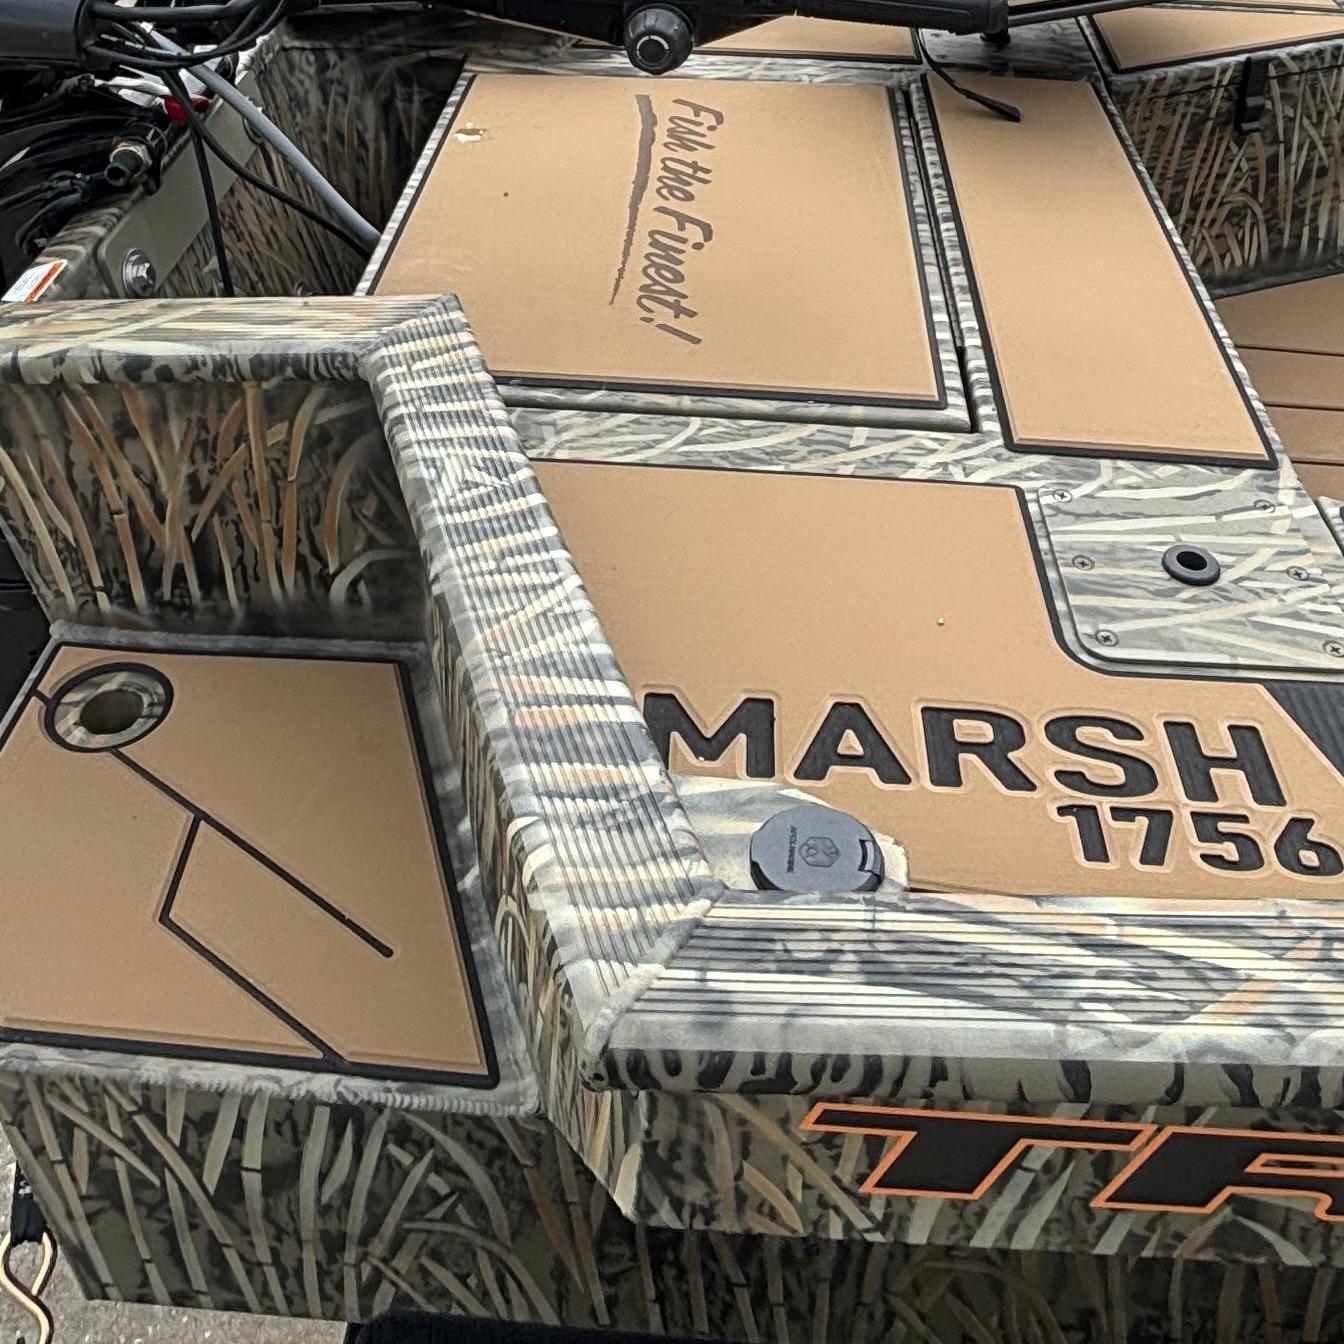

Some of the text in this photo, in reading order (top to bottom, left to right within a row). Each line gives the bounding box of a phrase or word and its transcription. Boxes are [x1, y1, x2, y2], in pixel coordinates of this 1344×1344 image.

[635, 97, 725, 345] Fish the Finest!
[641, 691, 1287, 808] MARSH
